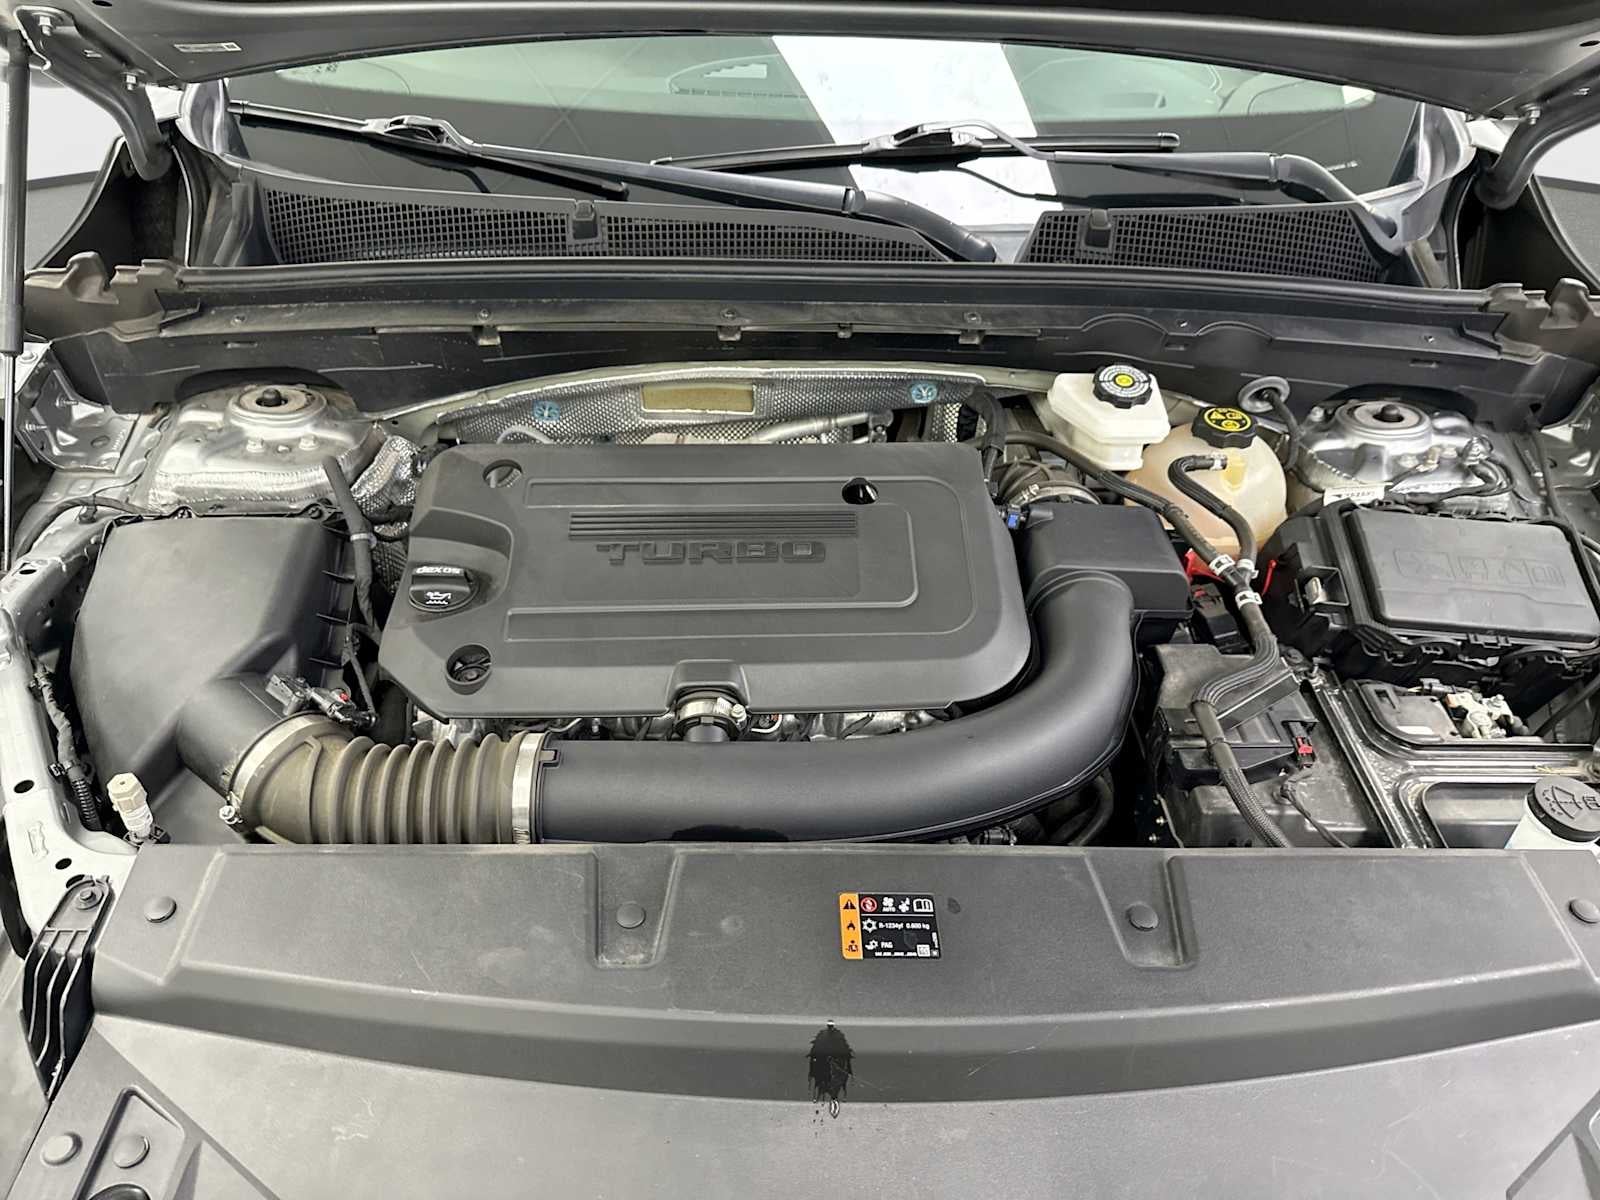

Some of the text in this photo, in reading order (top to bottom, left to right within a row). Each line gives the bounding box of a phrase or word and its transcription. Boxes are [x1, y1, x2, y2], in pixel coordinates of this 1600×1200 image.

[596, 540, 826, 565] TURBO
[922, 922, 930, 930] kg
[881, 941, 893, 949] PAG
